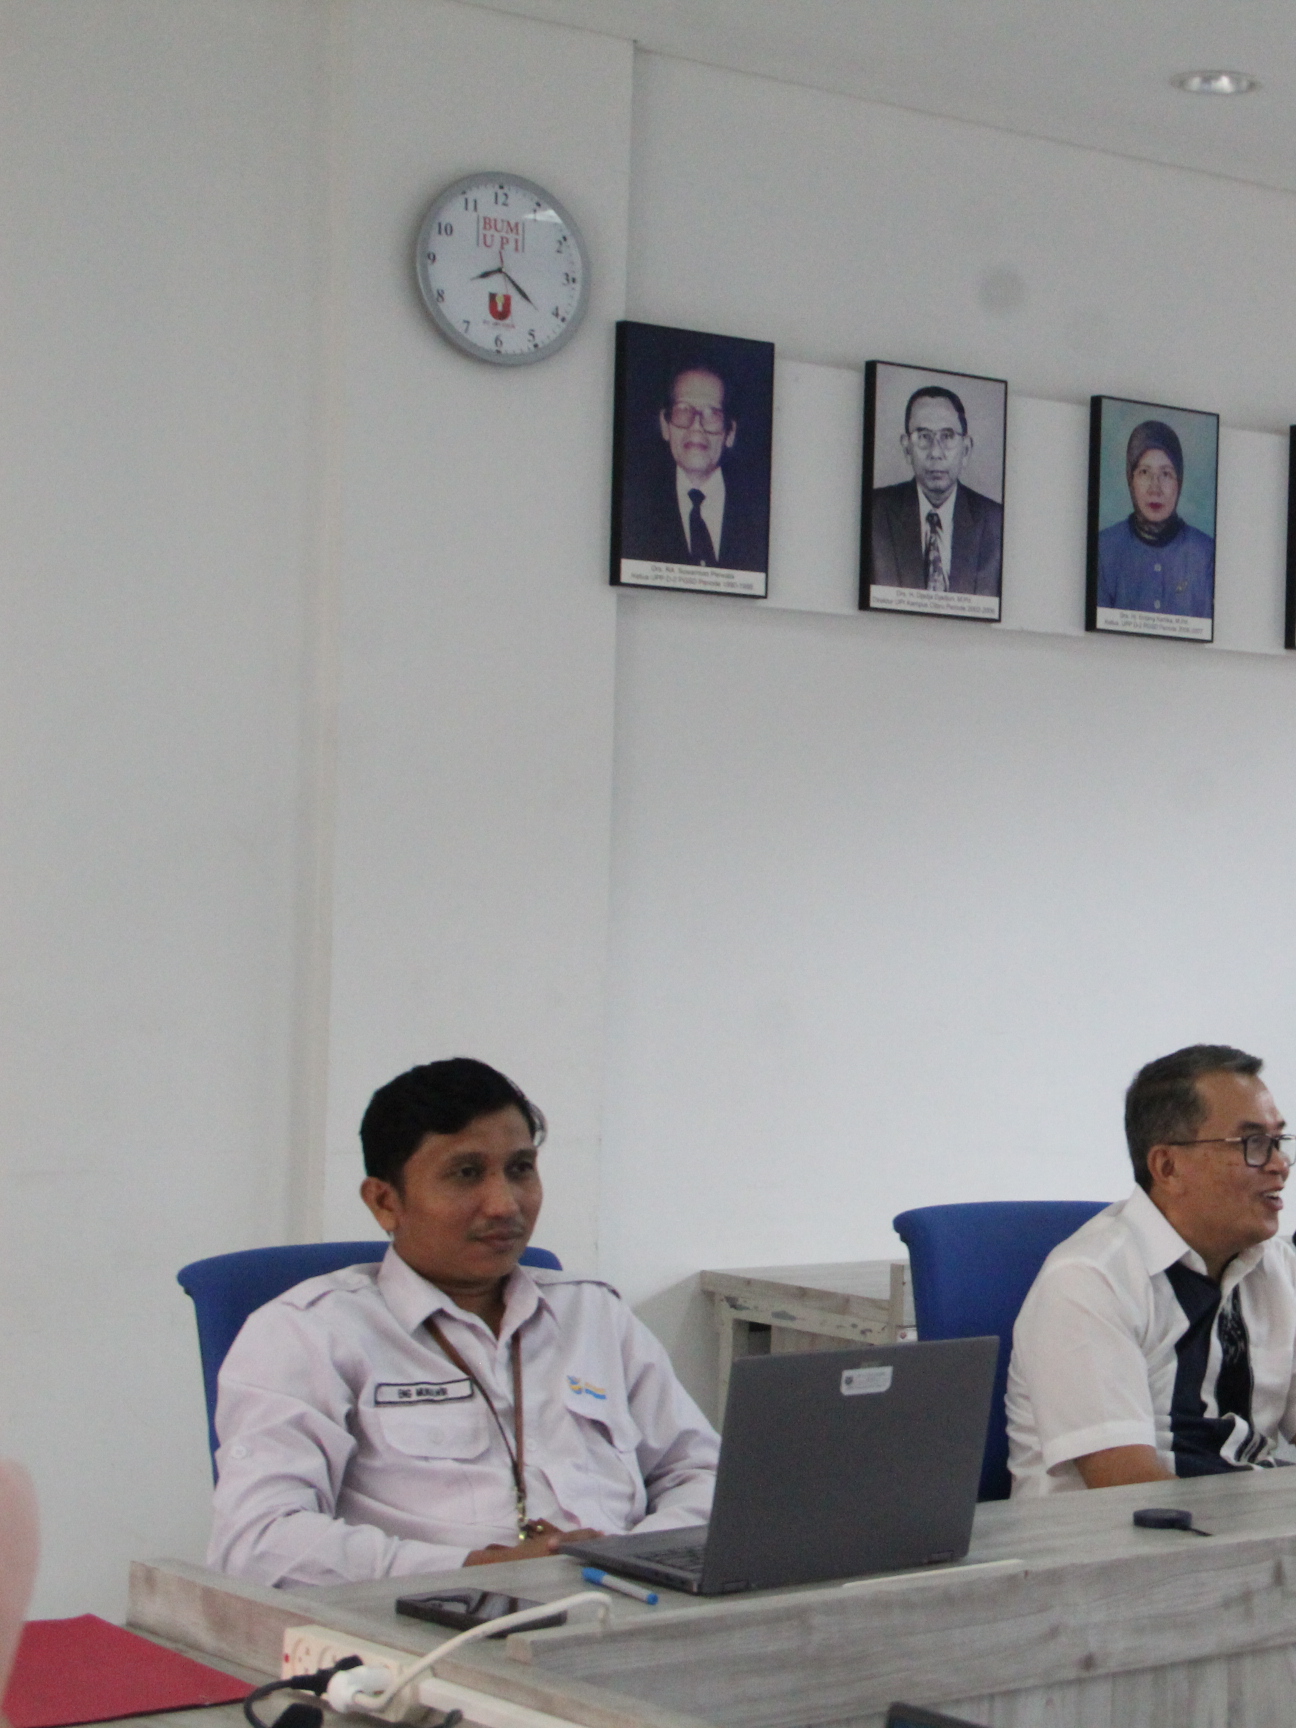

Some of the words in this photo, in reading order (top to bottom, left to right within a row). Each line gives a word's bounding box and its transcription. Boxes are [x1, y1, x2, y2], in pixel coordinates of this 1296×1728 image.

[464, 197, 478, 212] 11
[494, 192, 509, 207] 12
[437, 222, 453, 236] 10
[482, 215, 520, 236] BUM
[556, 239, 563, 254] 2
[428, 252, 436, 265] 9
[562, 272, 570, 286] 3
[436, 289, 445, 303] 8
[552, 306, 559, 319] 4
[463, 320, 471, 333] 7
[494, 335, 503, 348] 6
[528, 329, 536, 343] 5
